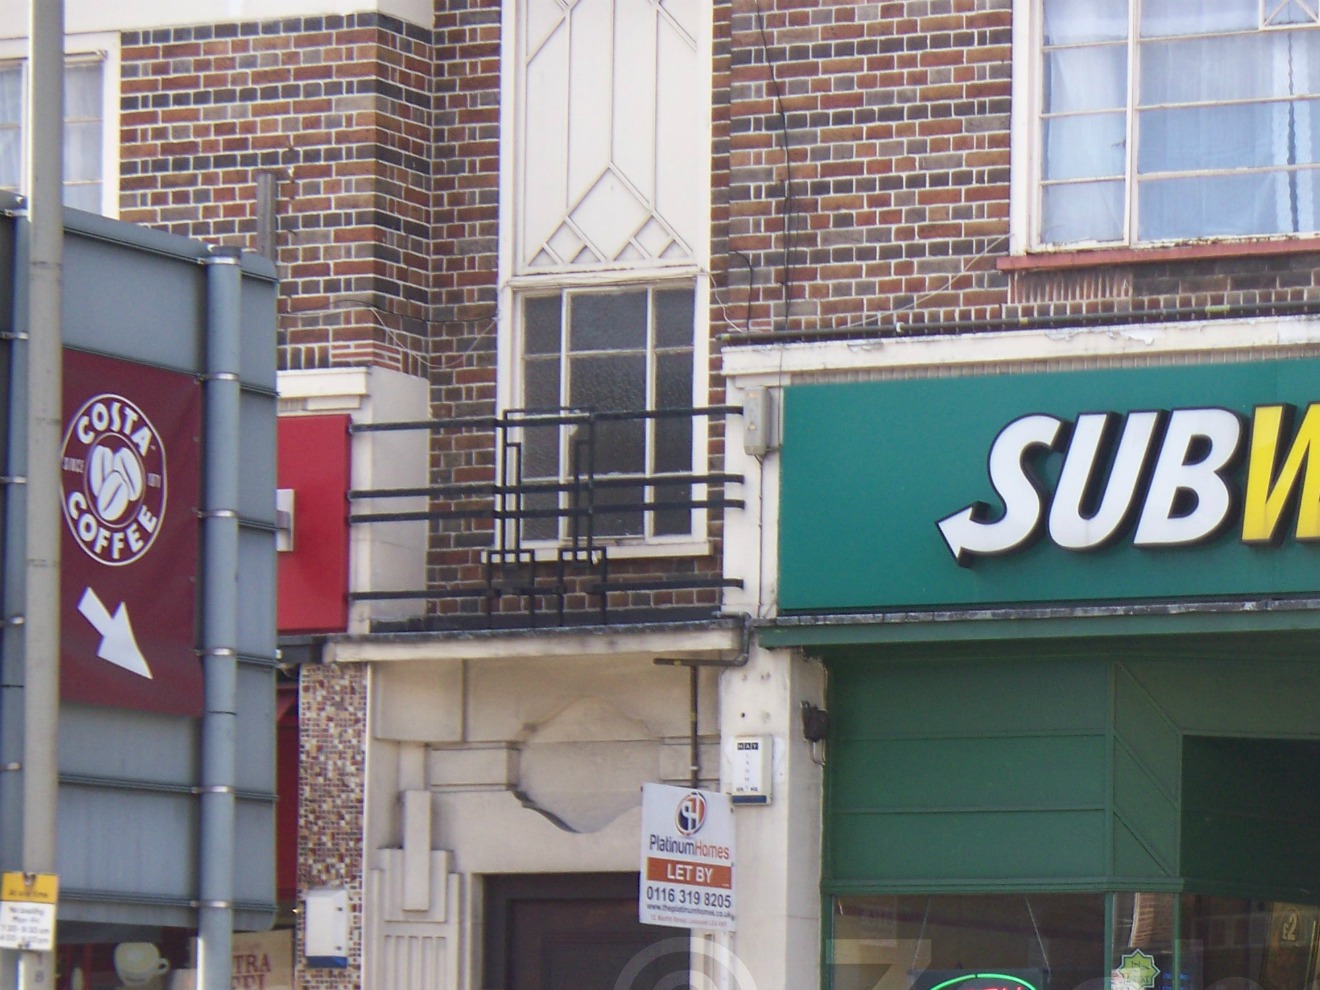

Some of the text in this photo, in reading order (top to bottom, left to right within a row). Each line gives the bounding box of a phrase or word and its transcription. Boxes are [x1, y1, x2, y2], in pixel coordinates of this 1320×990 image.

[77, 402, 152, 457] COSTA
[68, 491, 157, 559] COFFEE
[649, 834, 730, 860] PlatinumHomes
[667, 863, 713, 883] LET BY
[646, 886, 732, 909] 0116 319 8205
